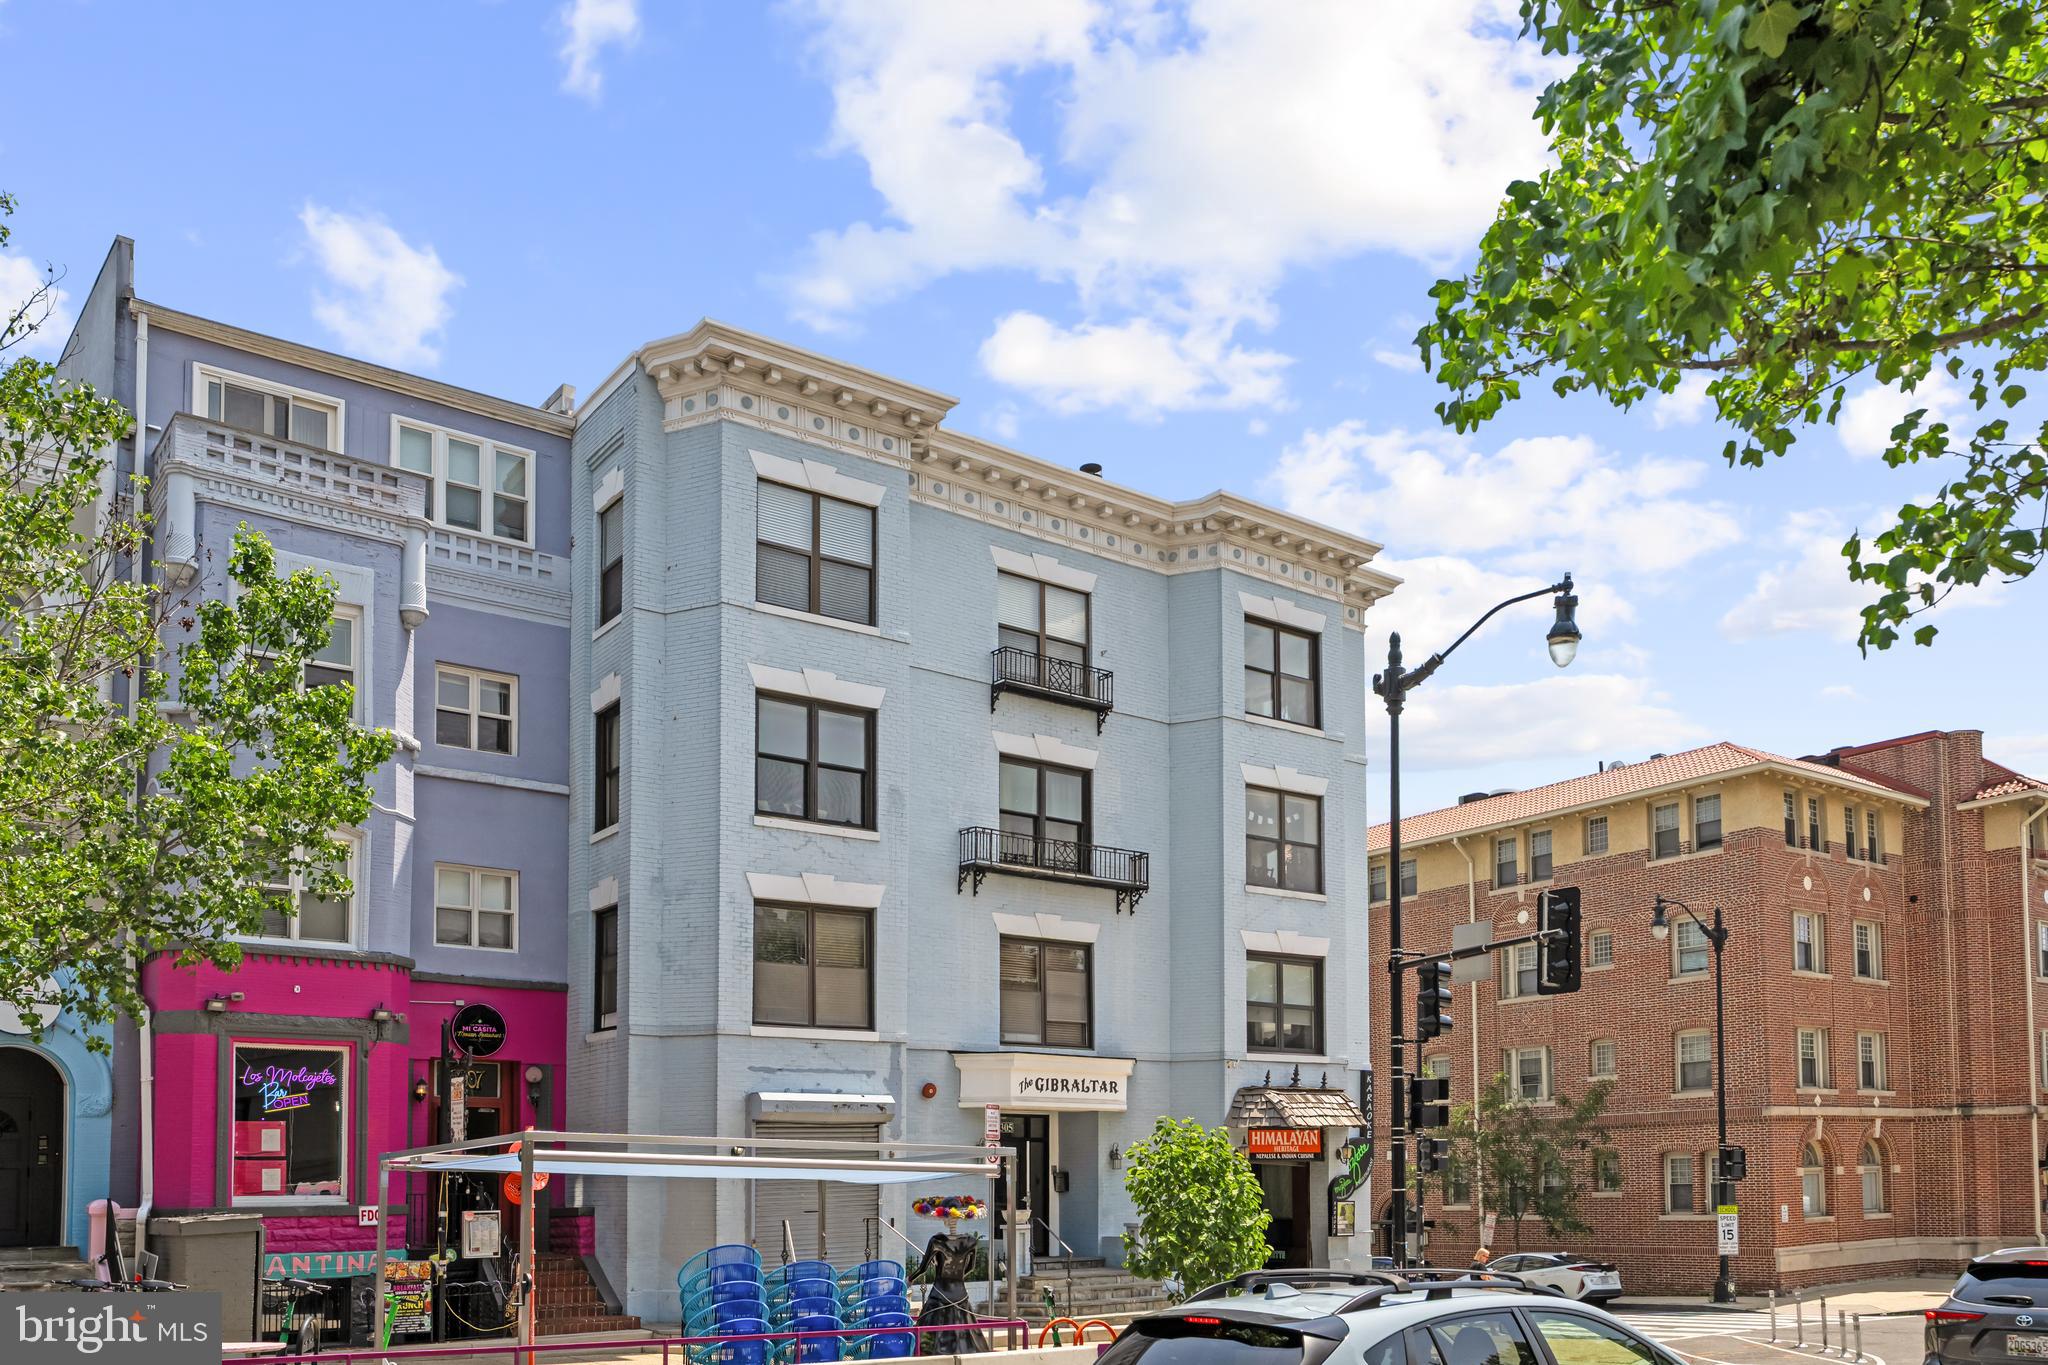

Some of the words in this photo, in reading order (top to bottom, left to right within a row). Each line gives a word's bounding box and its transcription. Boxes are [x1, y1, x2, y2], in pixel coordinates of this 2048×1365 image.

[243, 1065, 263, 1086] Los
[266, 1065, 337, 1091] Molcajetes
[467, 1070, 485, 1089] 07
[1018, 1077, 1034, 1094] The
[1034, 1077, 1119, 1094] GIBRALTAR
[258, 1081, 288, 1110] Bar
[273, 1095, 309, 1109] OPEN
[1001, 1123, 1013, 1132] 305
[1251, 1130, 1318, 1146] HIMALAYAN
[1273, 1145, 1300, 1153] HERITAGE
[1722, 1229, 1735, 1241] 15
[266, 1254, 377, 1276] ANTIN
[392, 1283, 423, 1292] BREAKFAST
[397, 1300, 424, 1310] RUNCH
